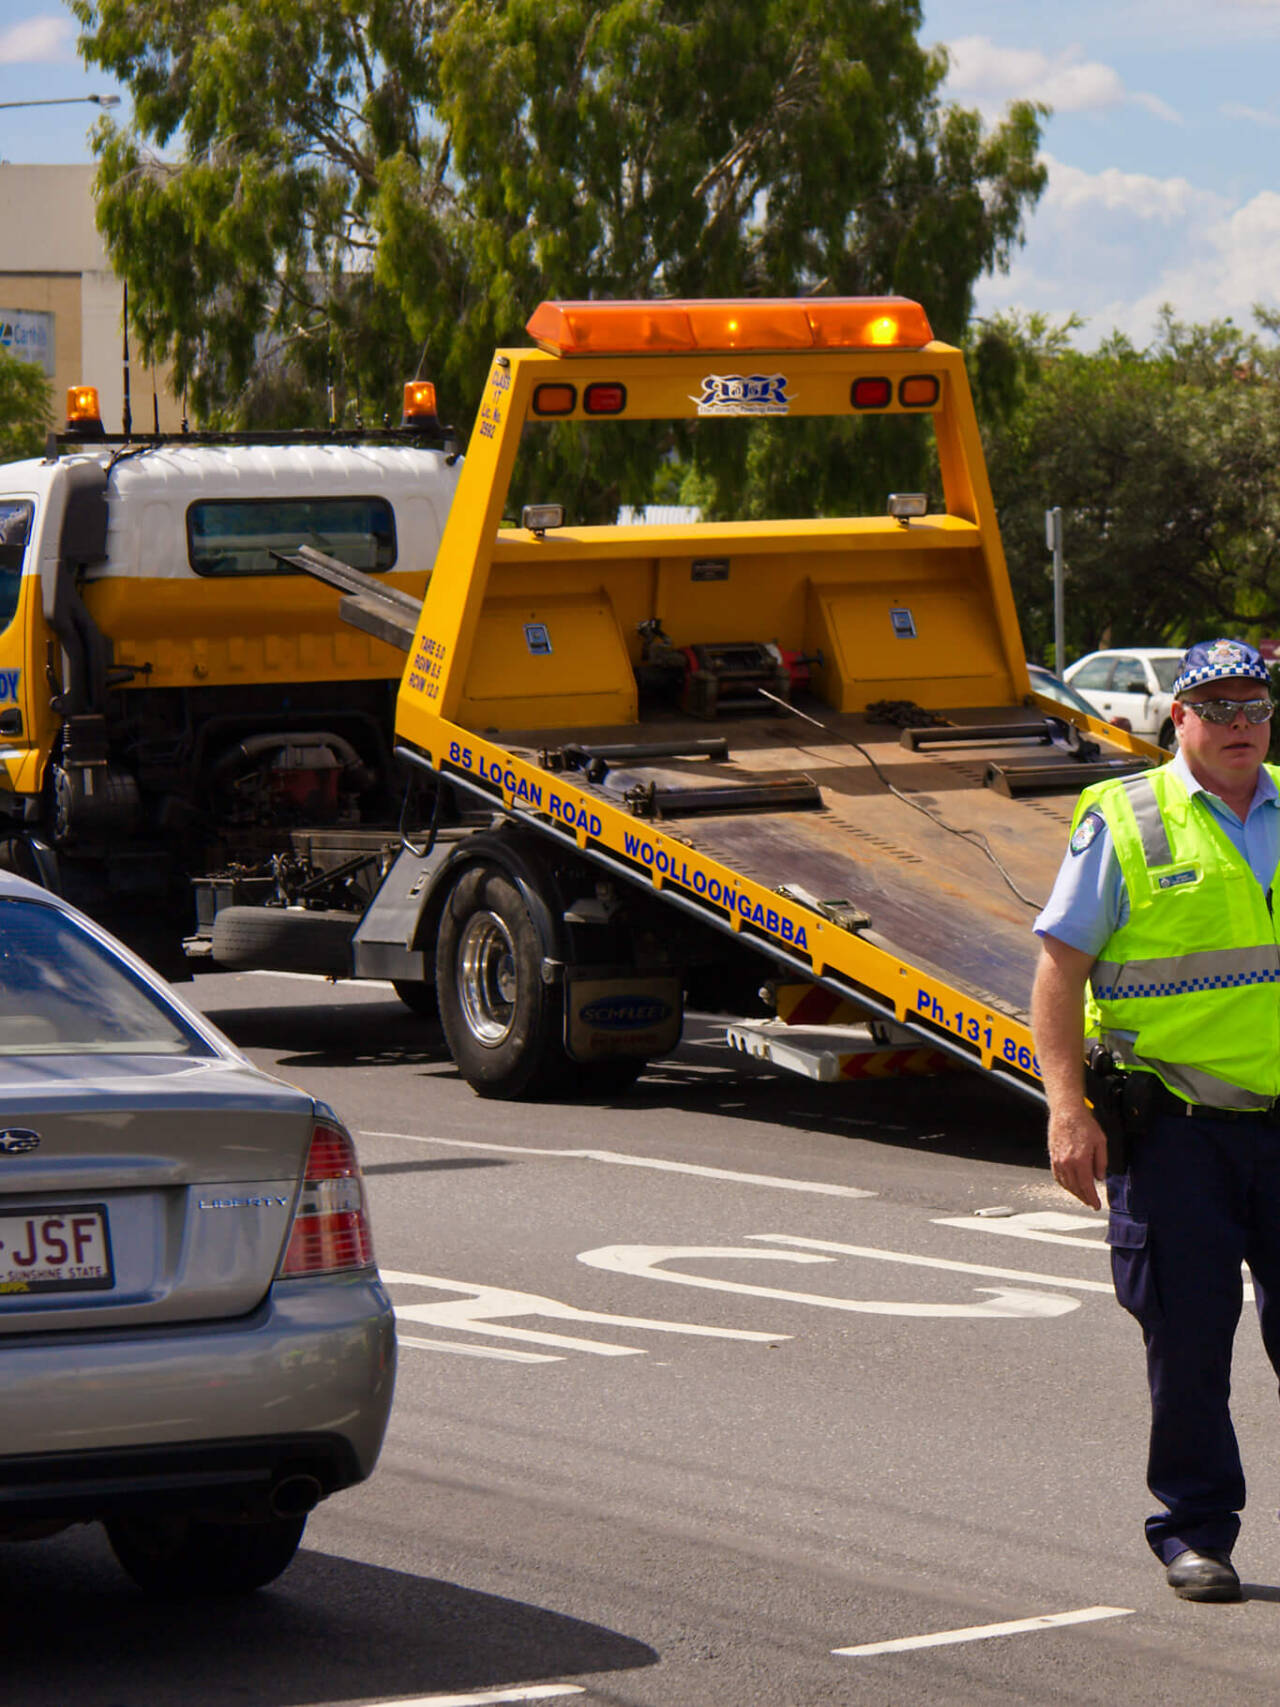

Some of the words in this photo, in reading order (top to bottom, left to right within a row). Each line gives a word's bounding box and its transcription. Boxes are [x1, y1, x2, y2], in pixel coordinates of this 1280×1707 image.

[450, 741, 472, 769] 85
[479, 755, 542, 807] LOGAN
[550, 792, 602, 838] ROAD
[624, 831, 808, 950] WOOLLOONGABBA
[12, 1218, 97, 1266] JSF
[8, 1267, 63, 1282] SUNSHINE
[69, 1265, 102, 1279] STATE
